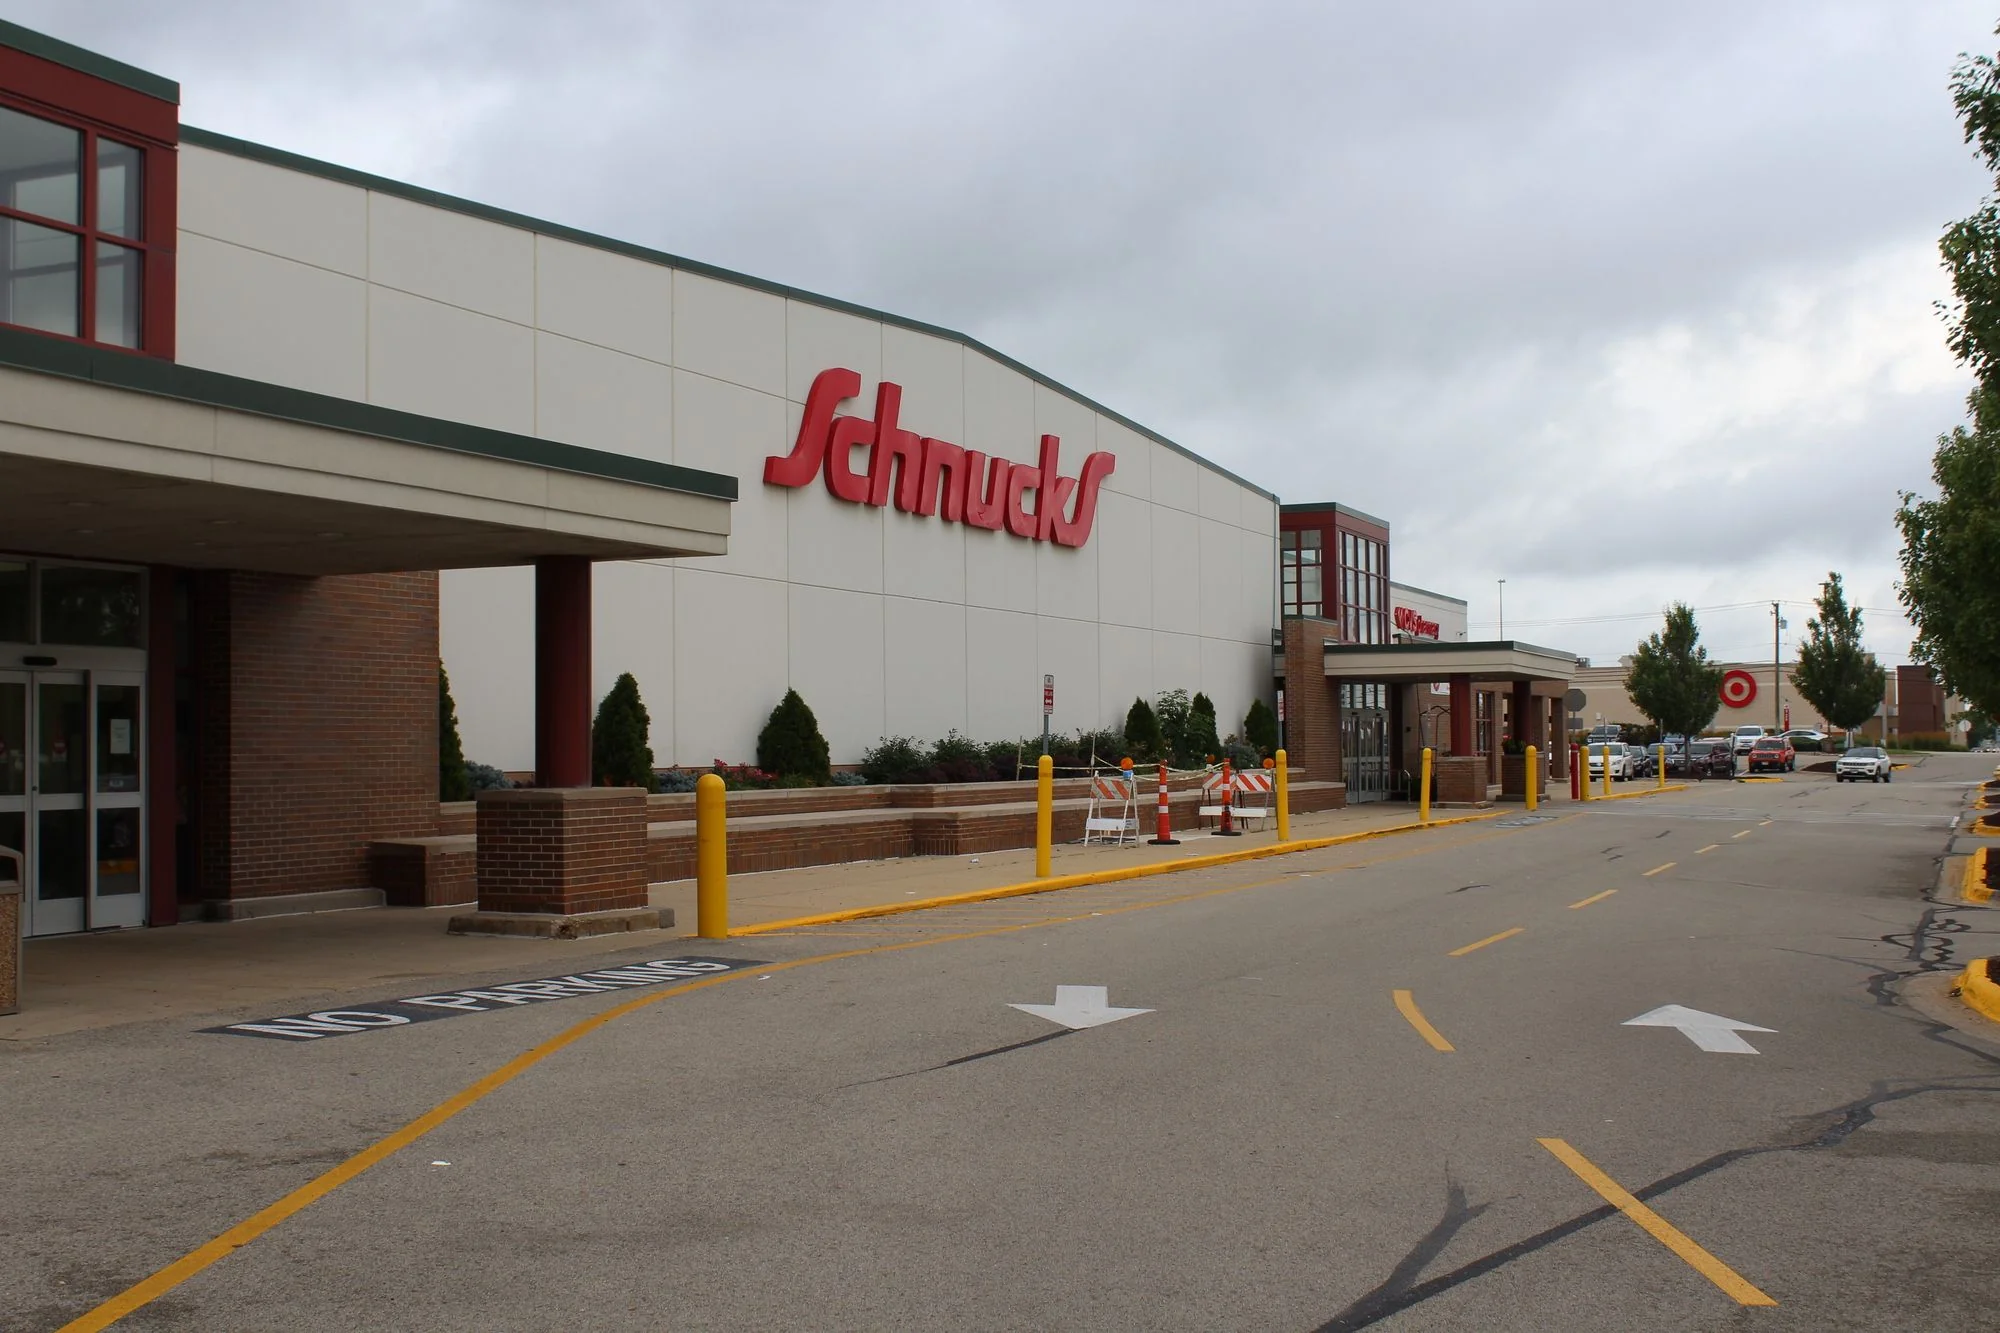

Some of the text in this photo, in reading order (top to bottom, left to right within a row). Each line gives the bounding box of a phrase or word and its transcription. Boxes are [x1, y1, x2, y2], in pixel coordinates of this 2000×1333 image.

[763, 367, 1115, 548] Schnucks
[226, 960, 731, 1039] NO PARKING
